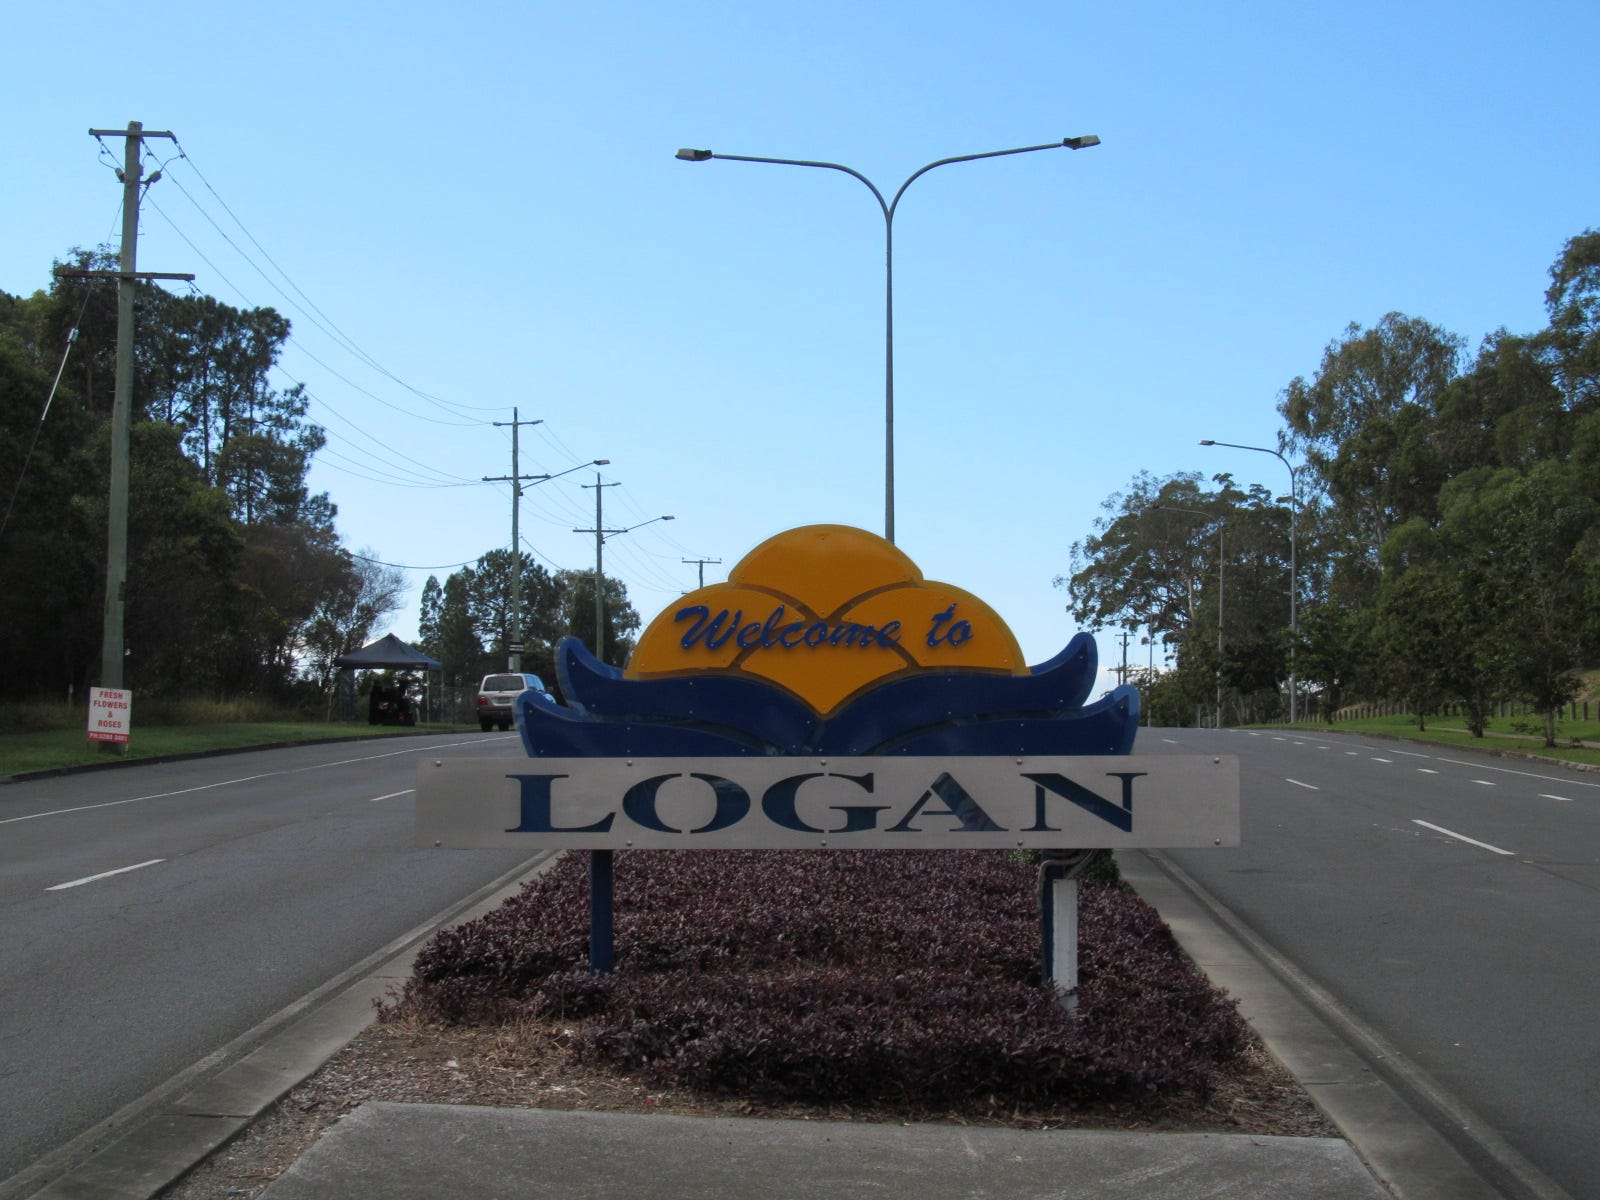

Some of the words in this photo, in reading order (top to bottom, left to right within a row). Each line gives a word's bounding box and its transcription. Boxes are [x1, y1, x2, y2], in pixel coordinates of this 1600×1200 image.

[674, 604, 902, 650] Welcome
[926, 602, 975, 648] to
[99, 690, 124, 699] FRESH
[93, 700, 128, 710] FLOWERS
[107, 711, 113, 719] &
[98, 720, 122, 729] ROSES
[505, 772, 1148, 834] LOGAN
